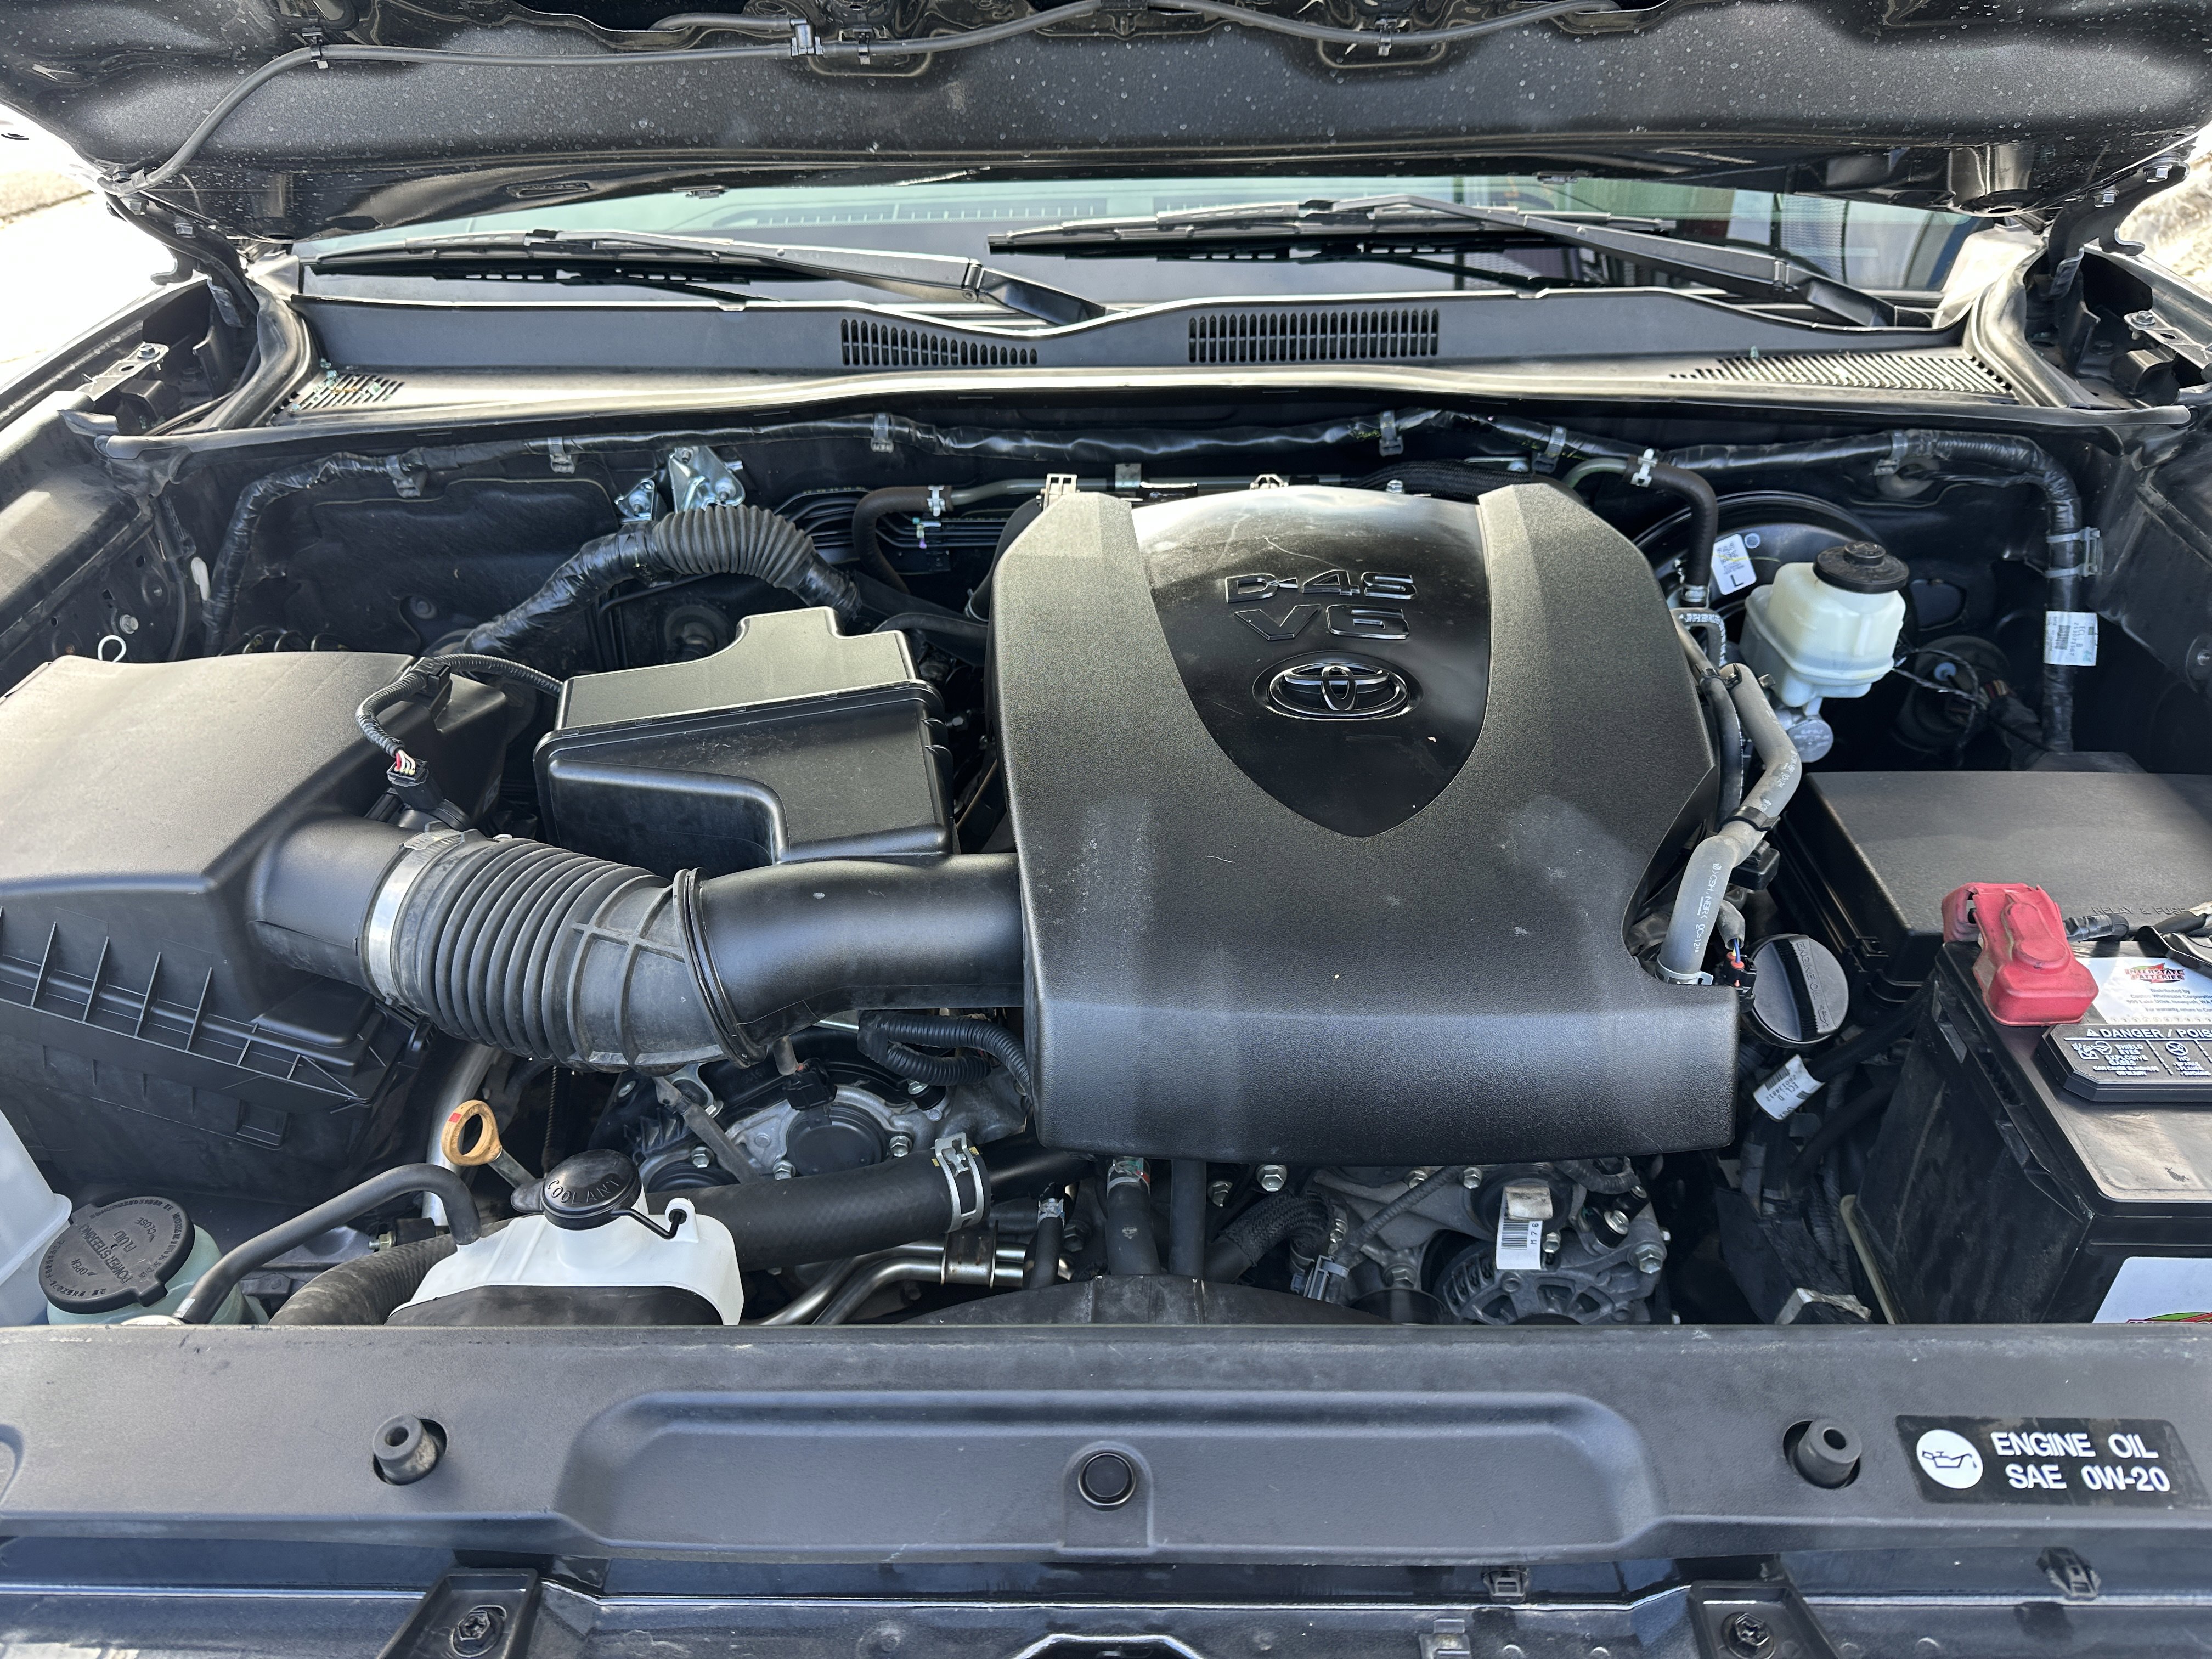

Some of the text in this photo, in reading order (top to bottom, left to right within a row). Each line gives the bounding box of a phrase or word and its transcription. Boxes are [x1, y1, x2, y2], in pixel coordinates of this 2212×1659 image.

[1225, 569, 1417, 603] D-4S
[1730, 575, 1744, 588] L
[1233, 603, 1410, 641] V6
[2091, 906, 2134, 915] RELAY
[1796, 941, 1821, 1000] ENGINE OIL
[2099, 1029, 2164, 1038] DANGER
[2175, 1029, 2212, 1038] POIS
[547, 1176, 620, 1205] COOLANT
[134, 1217, 156, 1234] CLOSE
[78, 1223, 133, 1284] POWER STEERING
[113, 1230, 137, 1253] FLUID
[71, 1259, 88, 1276] OPEN
[1990, 1431, 2159, 1459] ENGINE OIL
[2005, 1463, 2067, 1489] SAE
